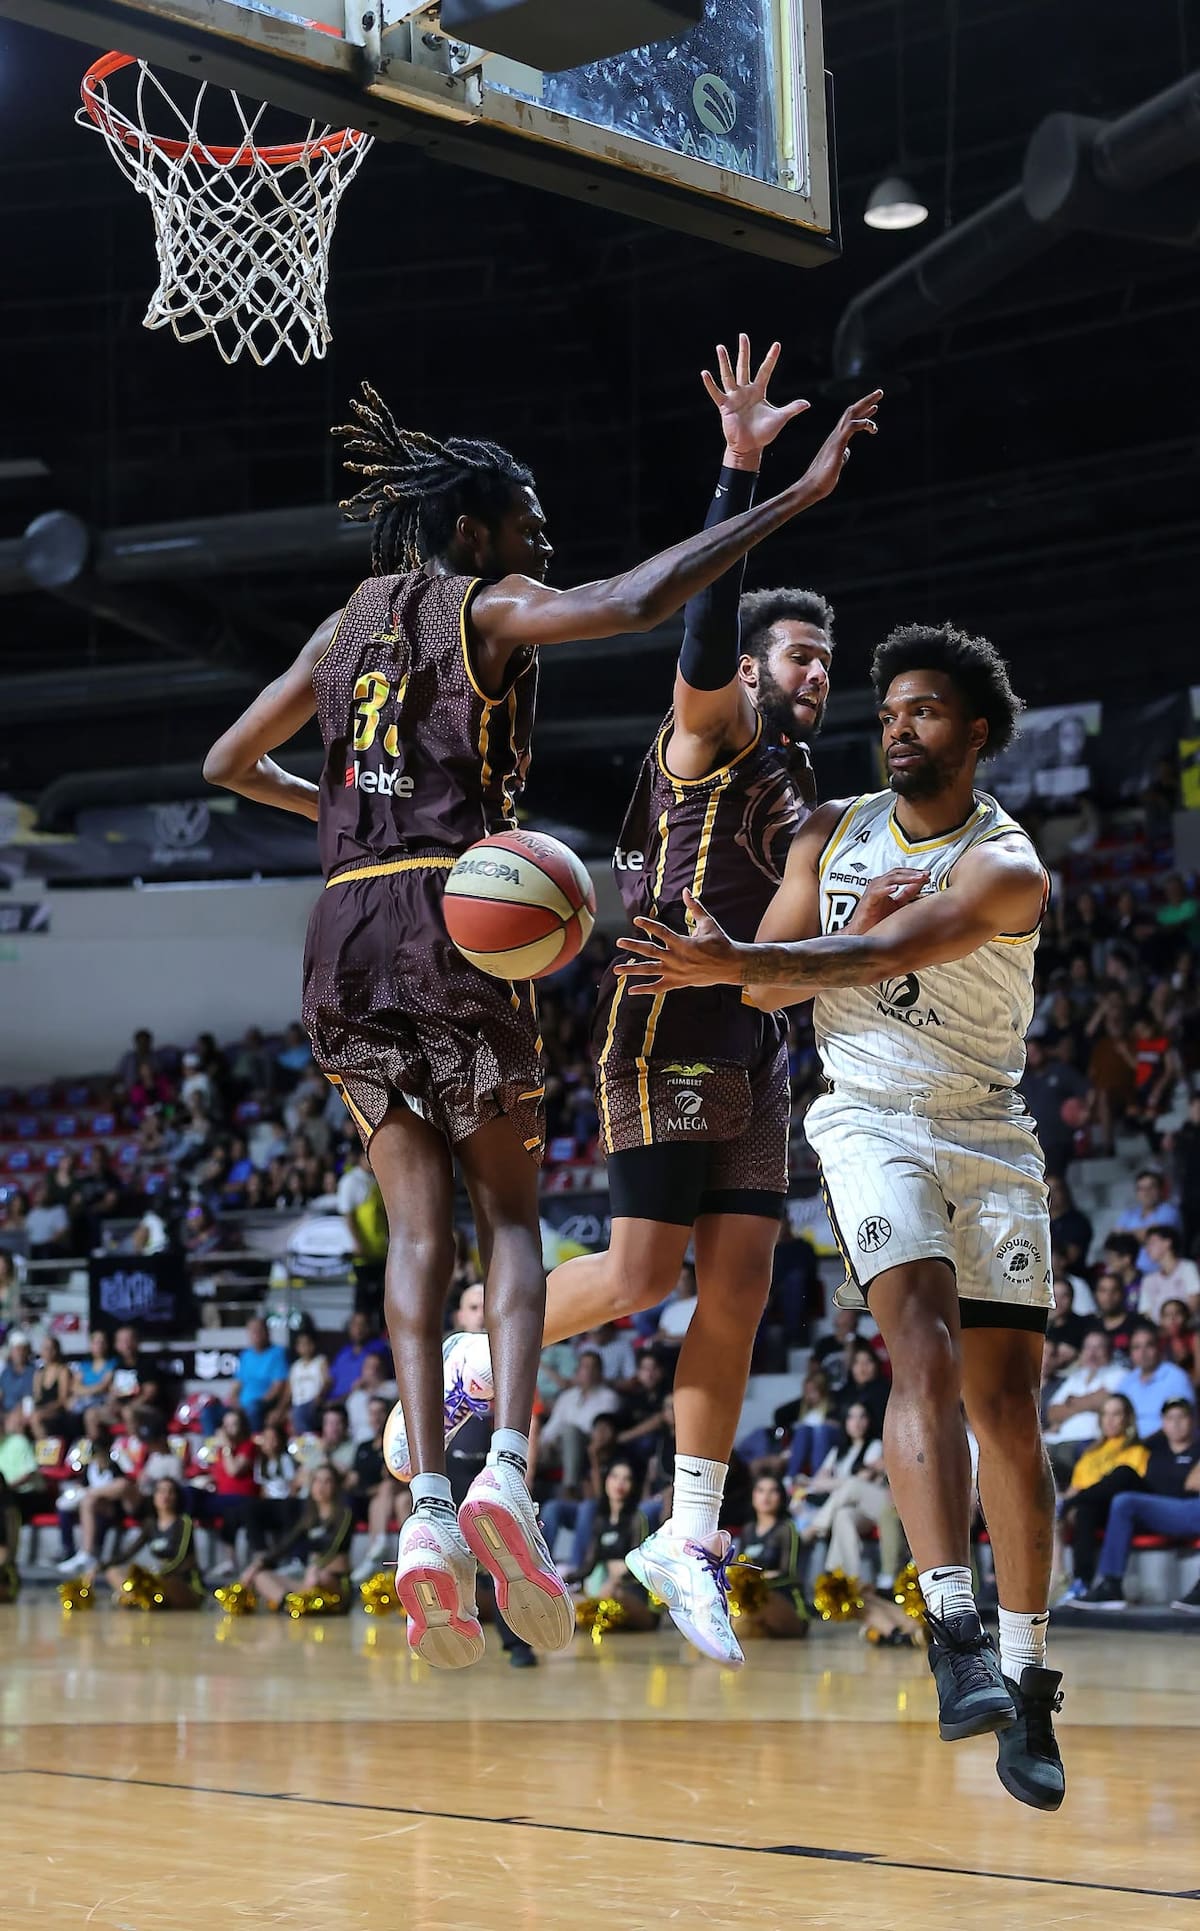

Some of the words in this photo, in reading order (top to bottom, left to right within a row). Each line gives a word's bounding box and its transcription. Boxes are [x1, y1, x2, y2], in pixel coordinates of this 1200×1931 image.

[667, 1116, 709, 1132] MEGA
[996, 1238, 1042, 1263] BUQUIBICHI
[402, 1537, 442, 1557] adidas
